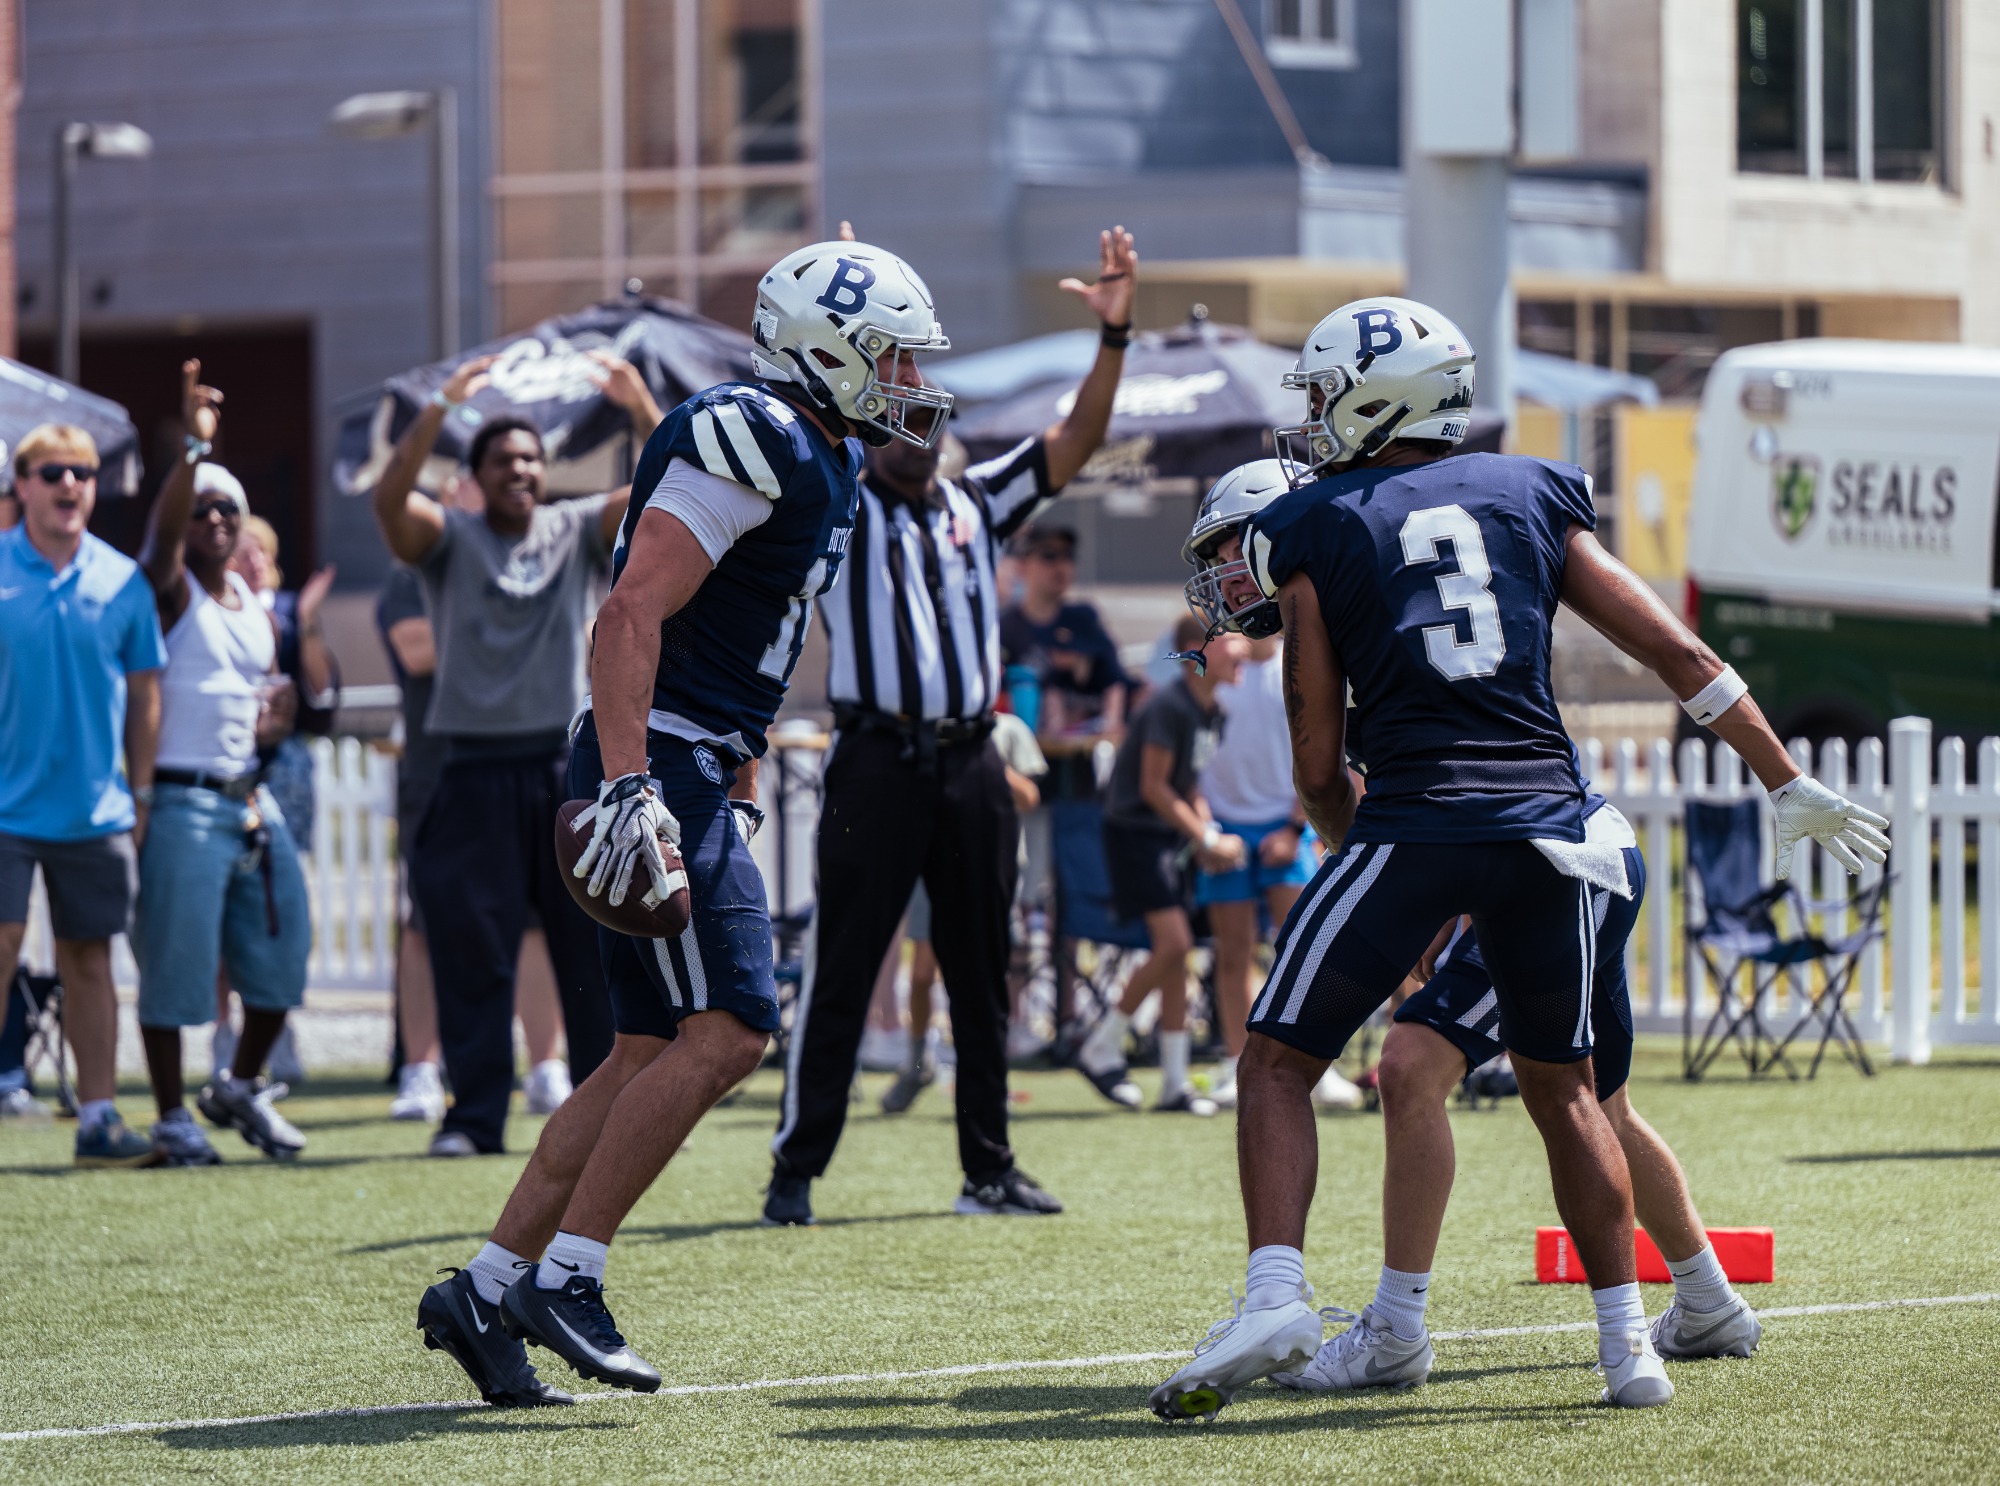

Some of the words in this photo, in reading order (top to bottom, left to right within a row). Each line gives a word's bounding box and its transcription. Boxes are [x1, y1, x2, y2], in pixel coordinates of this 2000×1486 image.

[815, 257, 876, 315] B
[1352, 308, 1403, 361] B
[1441, 422, 1467, 438] BULL
[1830, 461, 1957, 521] SEALS
[757, 557, 840, 682] 1
[1399, 504, 1506, 682] 3
